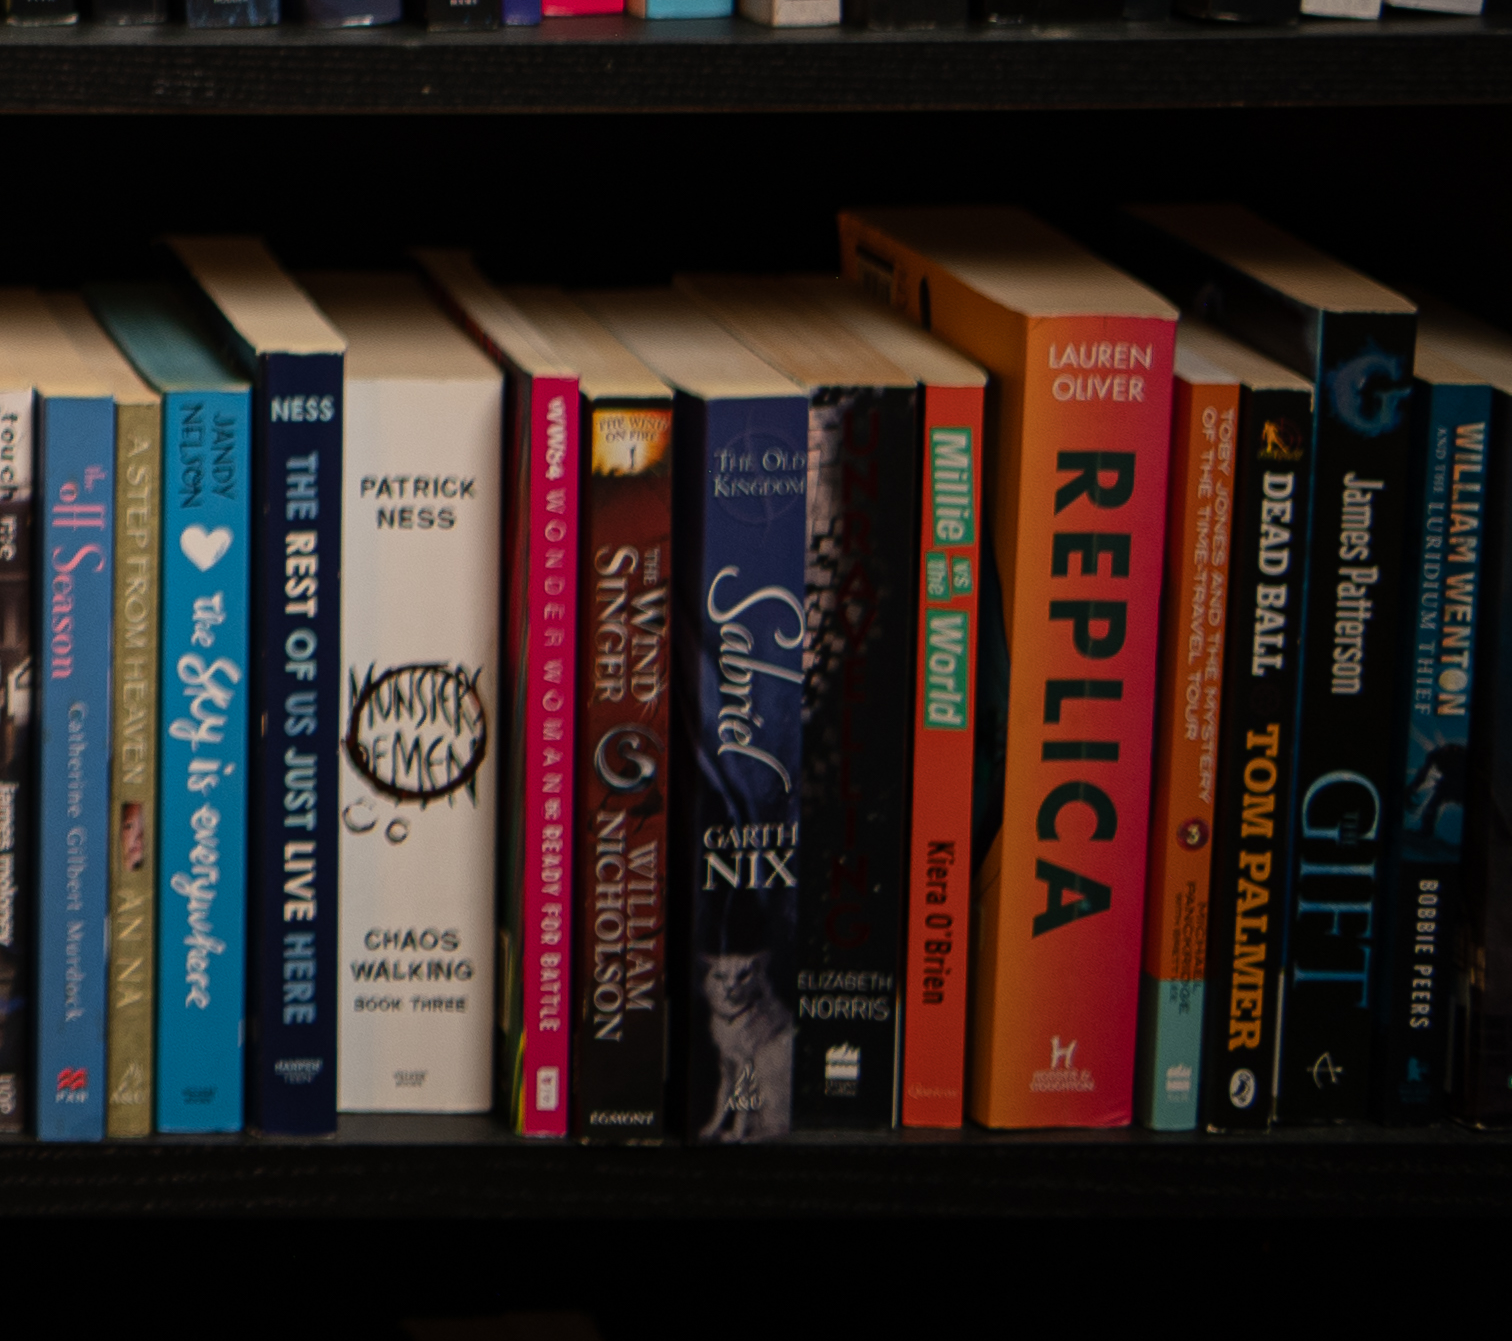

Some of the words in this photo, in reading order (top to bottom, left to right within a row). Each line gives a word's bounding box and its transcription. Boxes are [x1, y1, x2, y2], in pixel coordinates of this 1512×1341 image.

[1050, 343, 1152, 370] LAUREN
[271, 397, 334, 421] NESS
[1052, 375, 1144, 402] OLIVER
[285, 455, 317, 518] THE
[360, 477, 476, 501] PATRICK
[378, 508, 456, 529] NESS
[1259, 472, 1294, 576] DEAD
[285, 533, 318, 618] REST
[285, 629, 315, 675] OF
[1253, 589, 1286, 676] BALL
[285, 690, 317, 737] US
[1033, 451, 1135, 938] REPLICA
[285, 746, 315, 829] JUST
[1239, 725, 1279, 834] TOM
[703, 824, 798, 849] GARTH
[285, 842, 315, 922] LIVE
[703, 851, 797, 889] NIX
[365, 928, 458, 952] CHAOS
[1229, 847, 1273, 1049] PALMER
[283, 933, 315, 1025] HERE
[352, 961, 474, 983] WALKING
